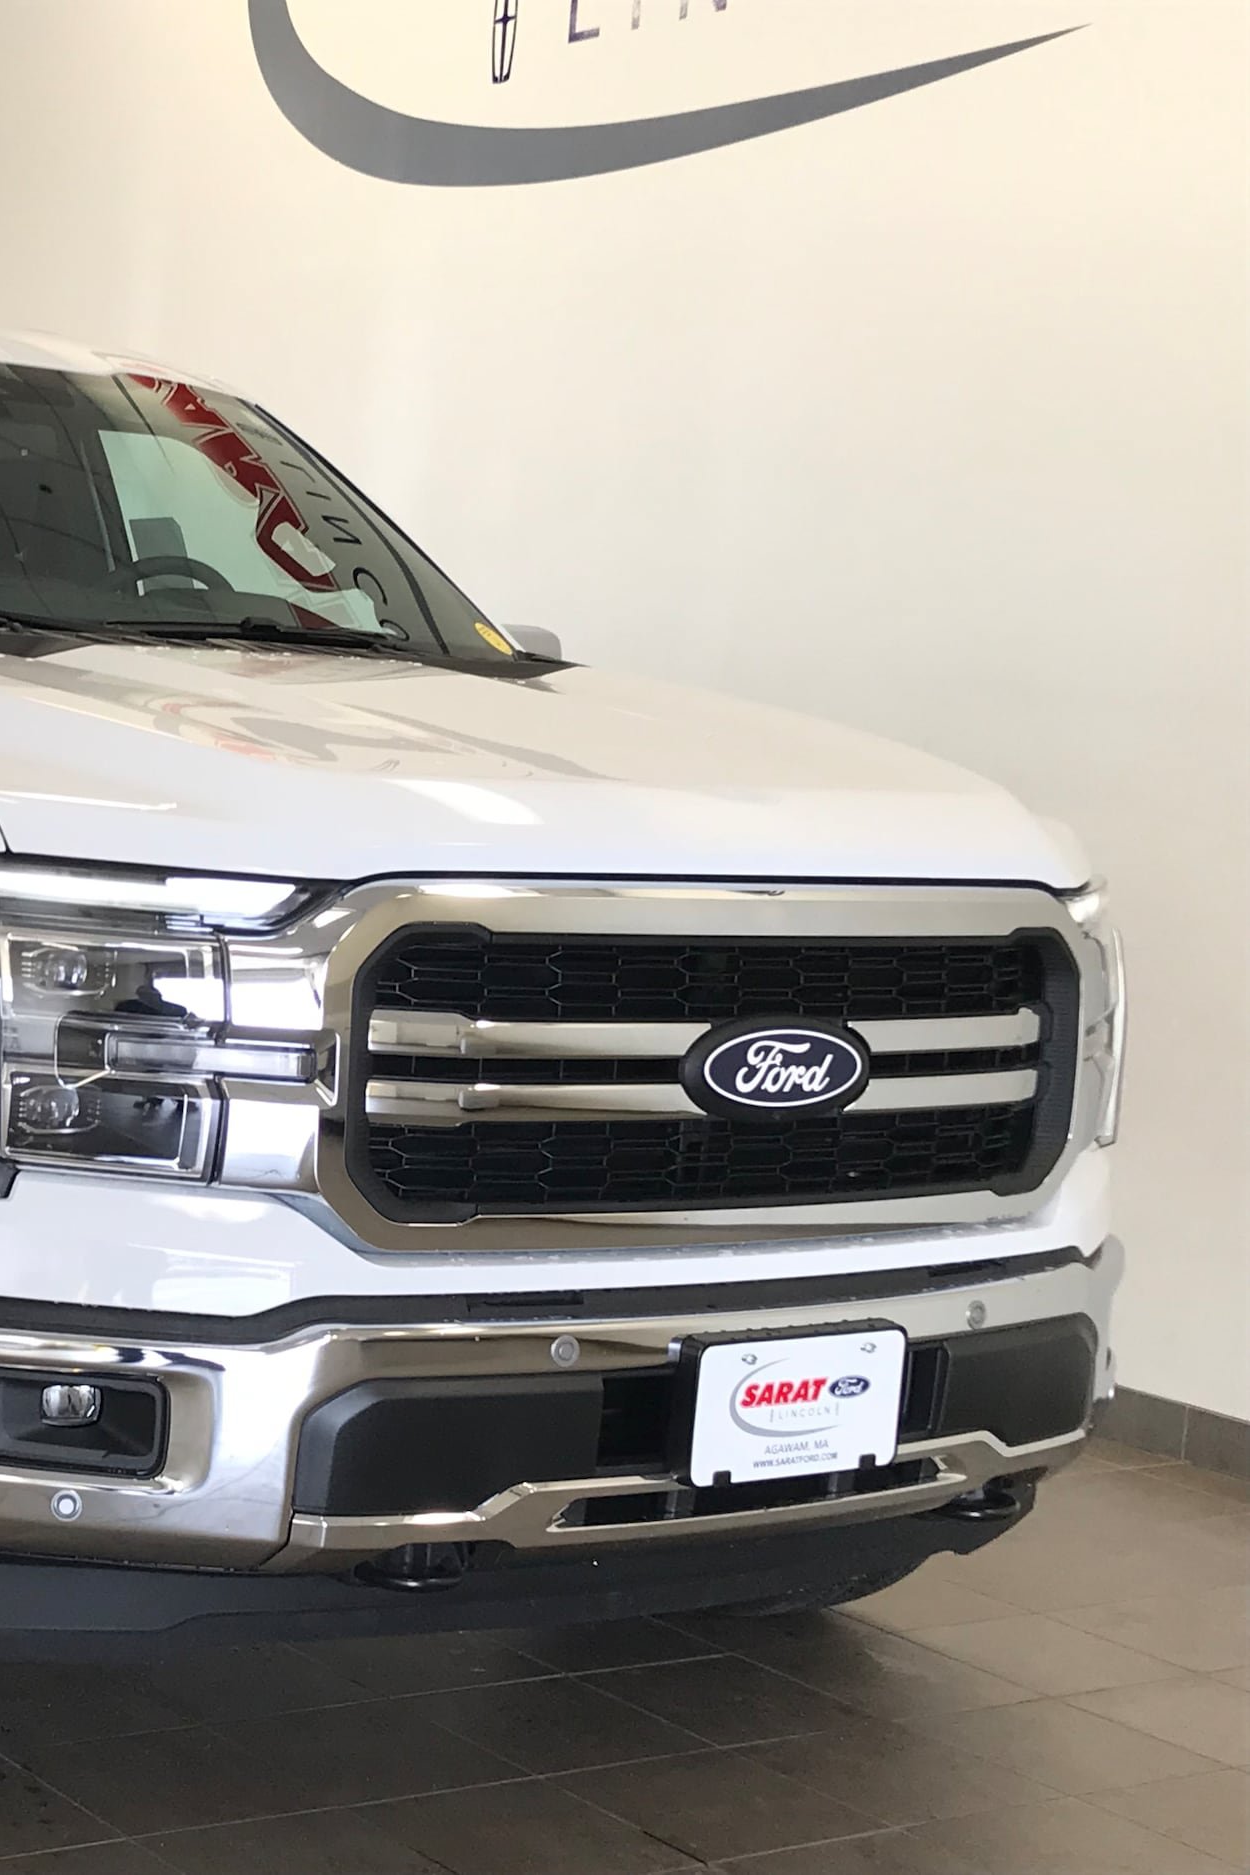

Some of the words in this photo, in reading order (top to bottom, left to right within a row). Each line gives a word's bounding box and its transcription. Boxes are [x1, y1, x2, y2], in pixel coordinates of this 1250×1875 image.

[735, 1040, 833, 1093] Ford
[741, 1378, 828, 1408] SARAT
[833, 1378, 865, 1396] Ford
[778, 1406, 831, 1420] LINCOLN
[814, 1439, 829, 1449] MA
